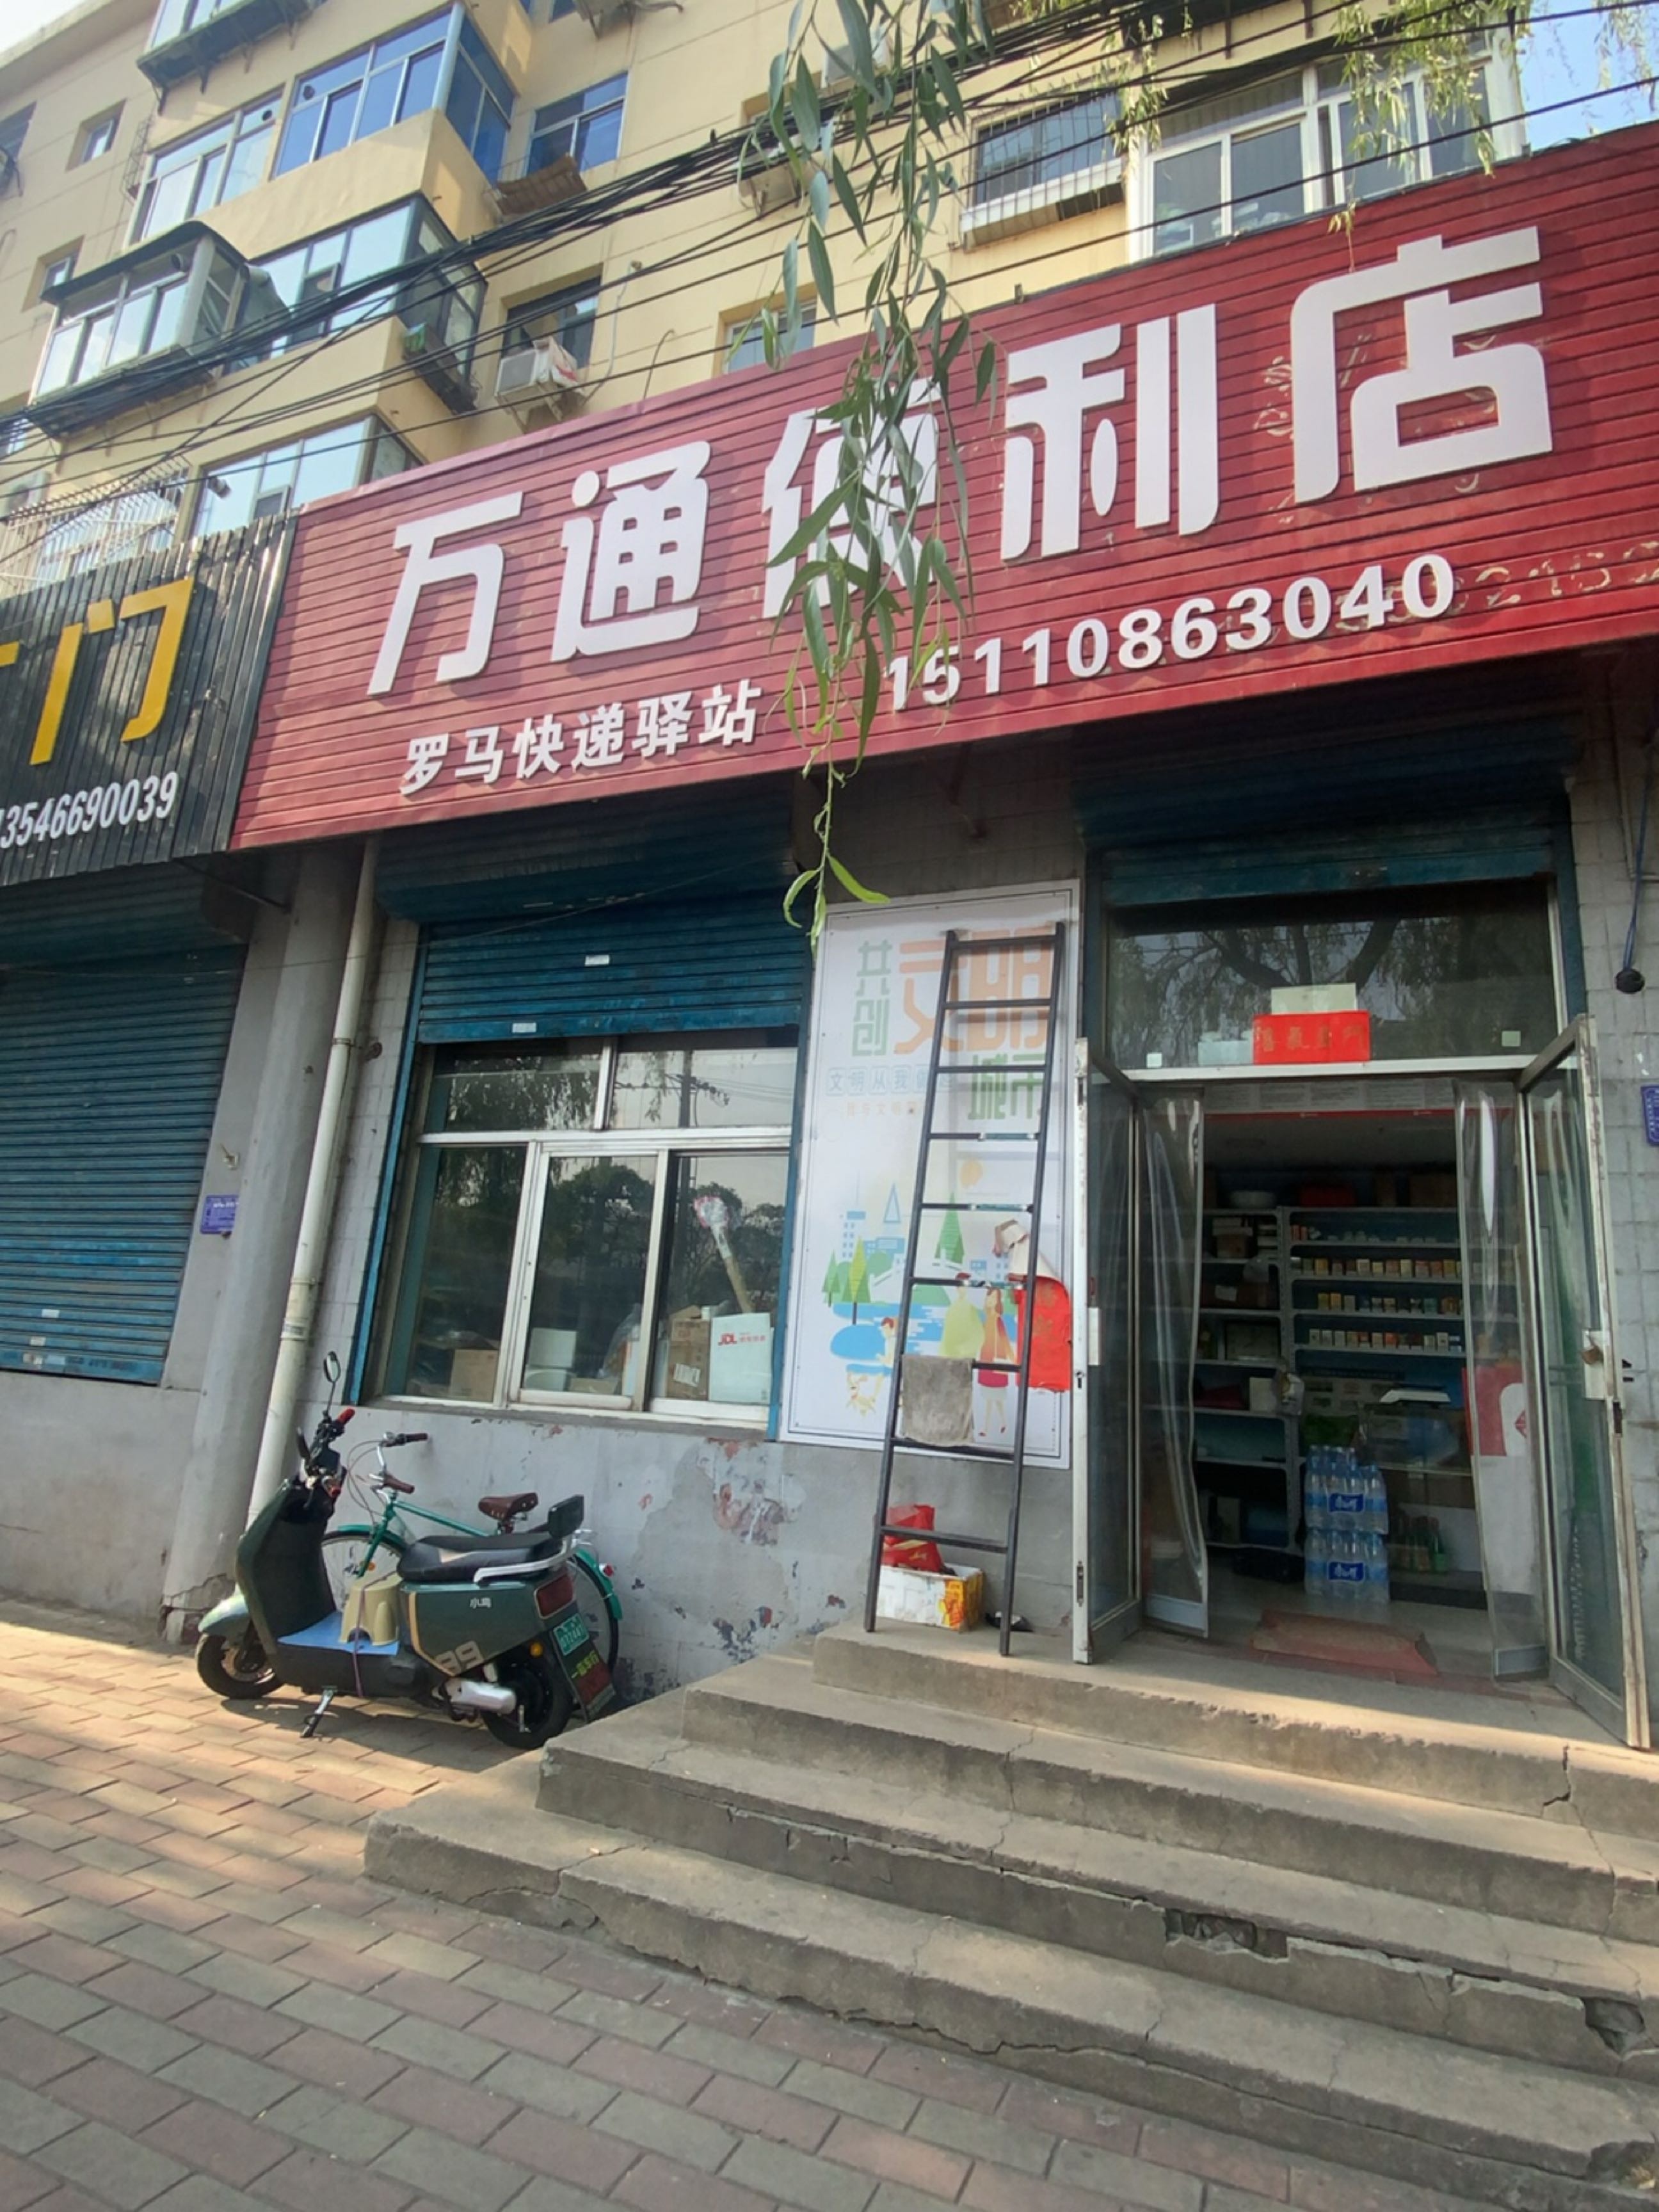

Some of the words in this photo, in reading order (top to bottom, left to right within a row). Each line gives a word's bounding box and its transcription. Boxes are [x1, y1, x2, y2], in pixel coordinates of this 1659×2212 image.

[367, 226, 1554, 696] 万通便利店
[0, 575, 193, 765] 门
[884, 554, 1454, 711] 15110863040
[0, 771, 179, 849] 3546690039
[399, 678, 762, 796] 罗马快递驿站
